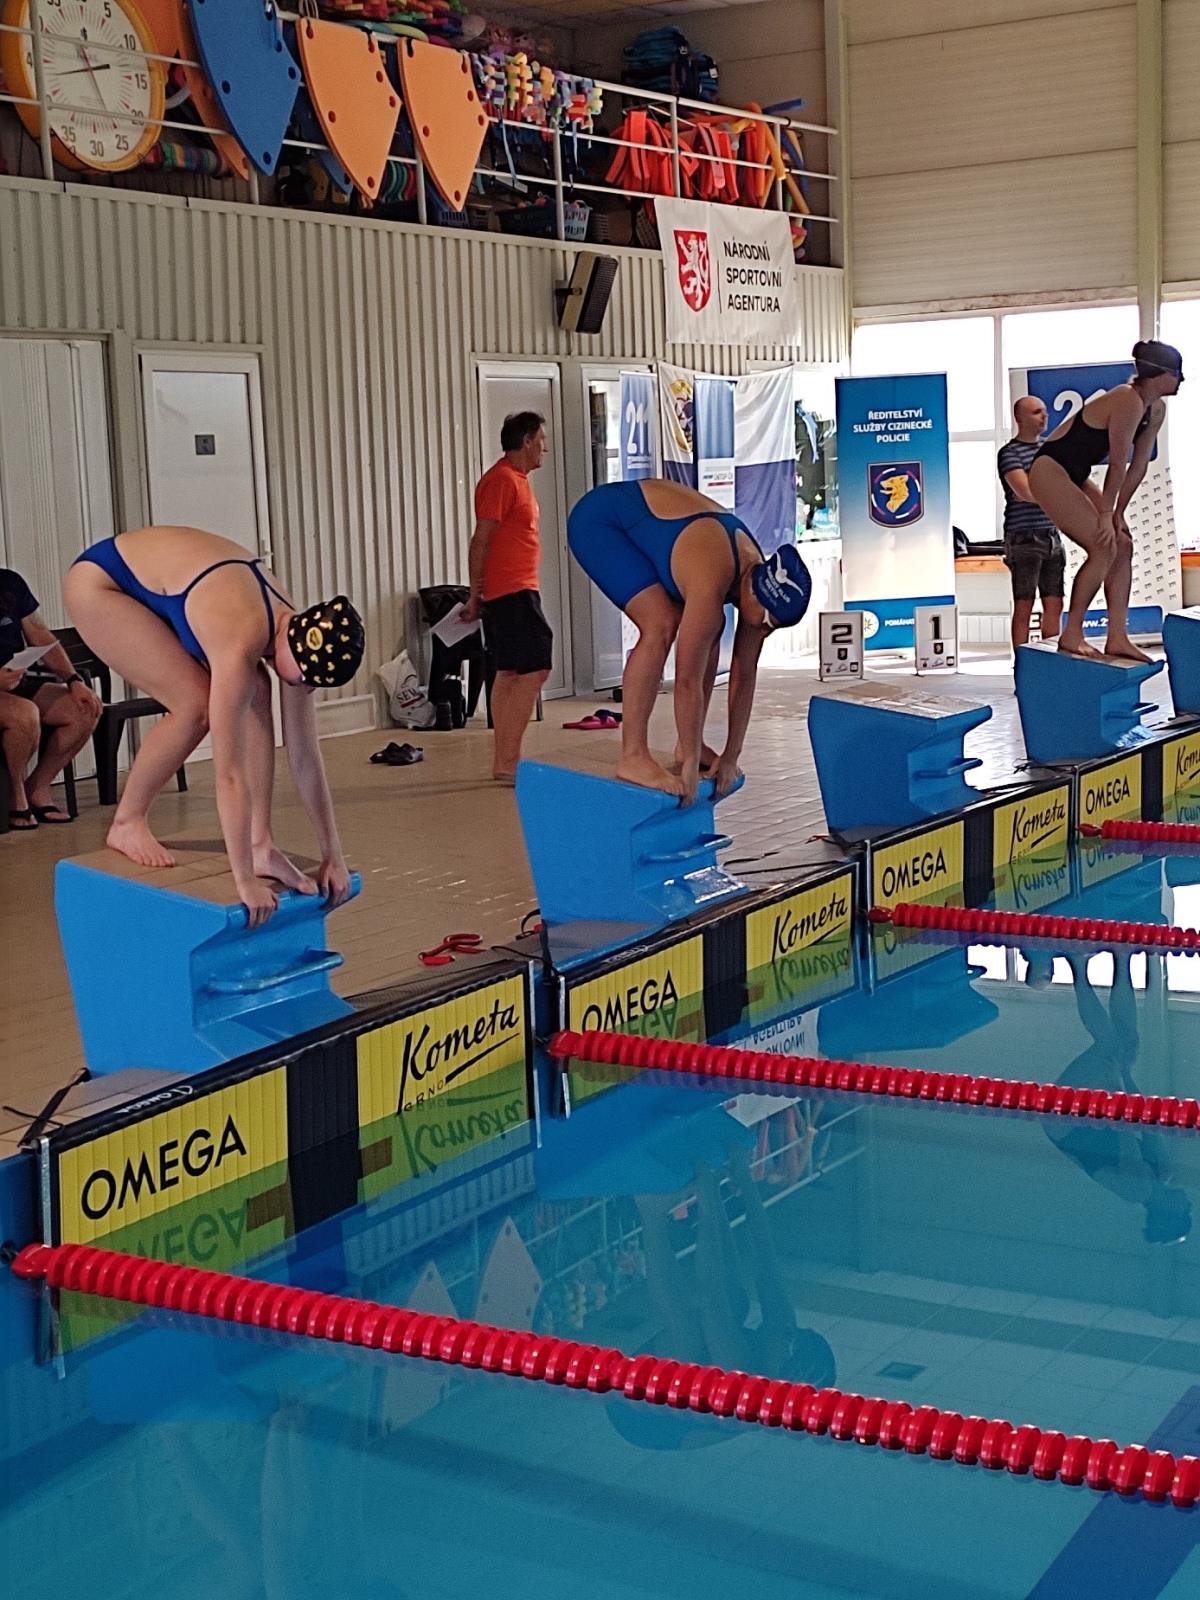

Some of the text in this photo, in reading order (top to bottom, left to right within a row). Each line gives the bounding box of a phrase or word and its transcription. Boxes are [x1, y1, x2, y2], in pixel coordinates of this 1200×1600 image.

[104, 2, 112, 18] 5
[123, 34, 136, 51] 10
[135, 73, 148, 90] 15
[61, 125, 77, 143] 35
[115, 134, 129, 150] 25
[90, 140, 105, 157] 30
[723, 236, 770, 261] NÁRODNÍ
[726, 267, 782, 288] SPORTOVNÍ
[727, 293, 781, 313] AGENTURA
[853, 418, 933, 433] SLUŽBY CIZINECKÉ
[876, 433, 911, 444] POLICIE
[831, 624, 853, 645] 2
[929, 615, 942, 640] 1
[1085, 774, 1131, 815] OMEGA
[1009, 798, 1066, 864] Kometa
[882, 848, 947, 898] OMEGA
[772, 892, 848, 963] Kometa
[582, 969, 679, 1033] OMEGA
[397, 999, 520, 1116] Kometa
[81, 1114, 247, 1220] OMEGA
